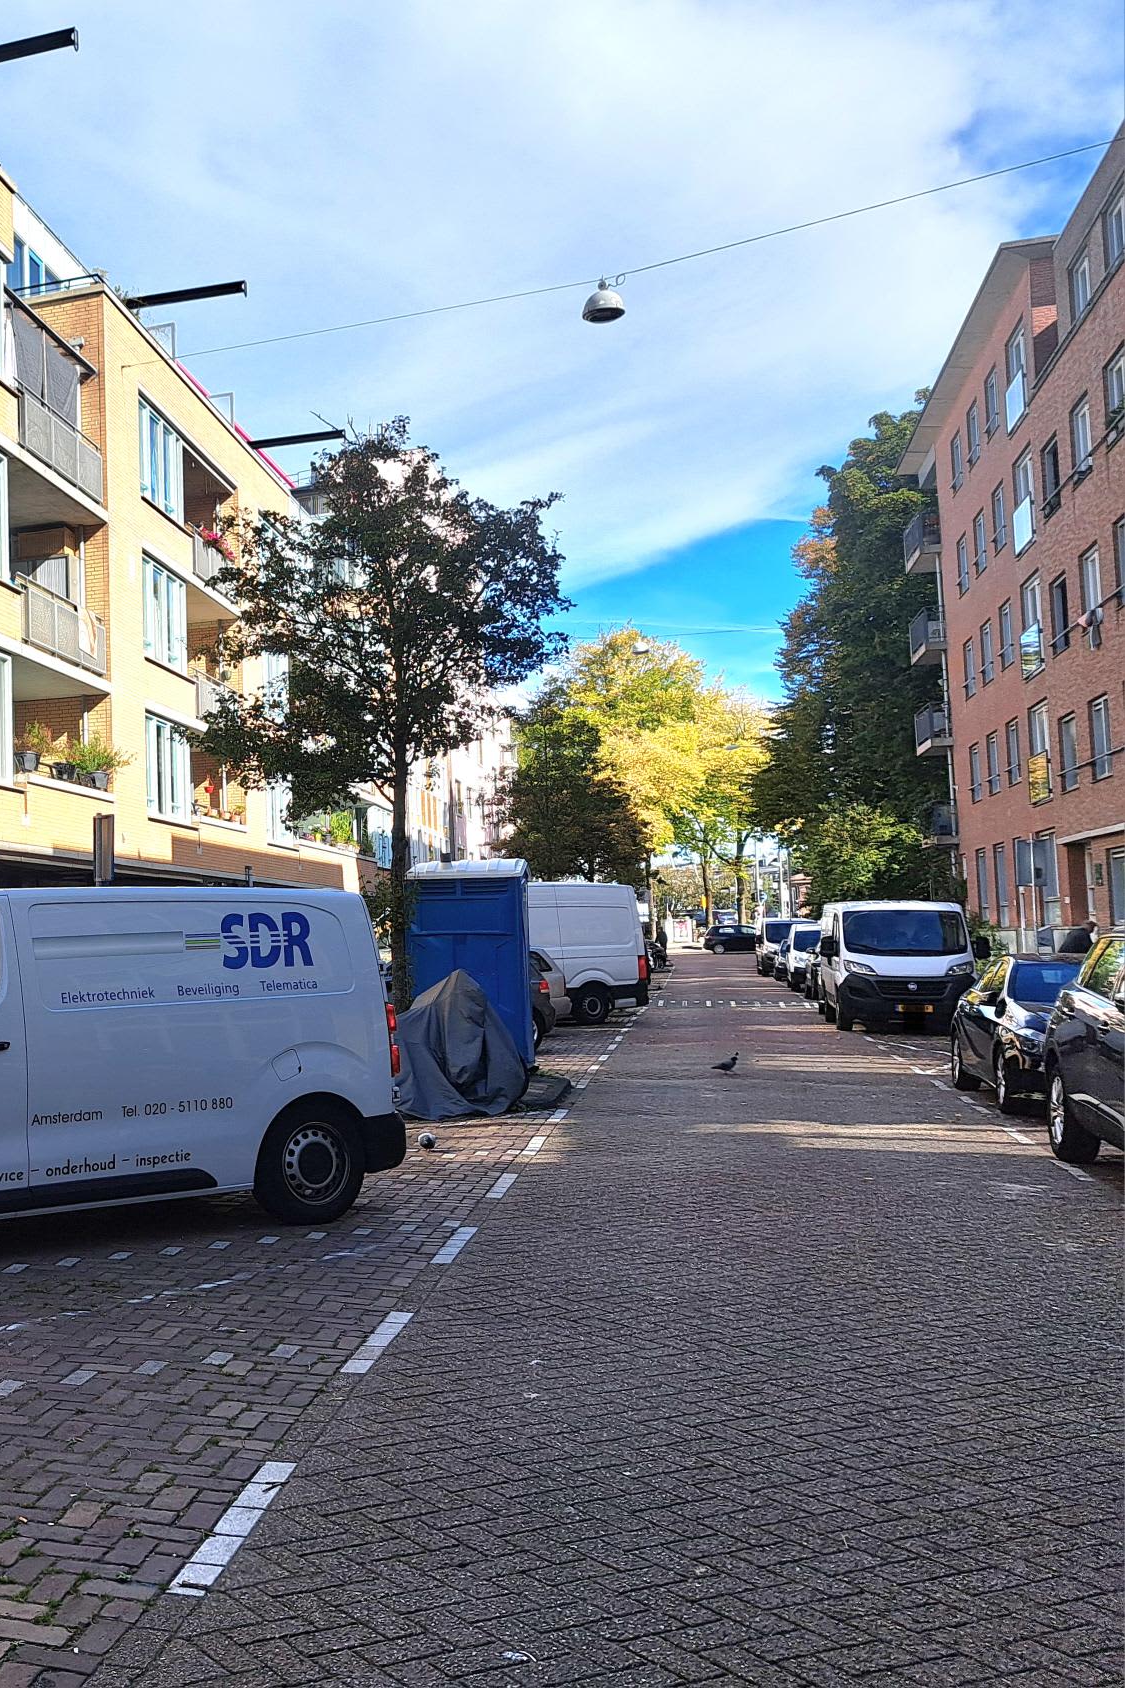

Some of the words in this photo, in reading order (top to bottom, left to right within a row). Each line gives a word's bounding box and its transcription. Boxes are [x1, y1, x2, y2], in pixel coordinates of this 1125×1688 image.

[221, 911, 314, 969] SDR
[60, 986, 156, 1004] Elektrotechniek
[177, 982, 240, 997] Beveiliging
[259, 979, 318, 992] Telematica
[31, 1109, 103, 1126] Amsterdam
[121, 1105, 140, 1118] Tel.
[144, 1102, 167, 1116] 020
[178, 1099, 208, 1113] 5110
[211, 1097, 233, 1110] 880
[45, 1154, 116, 1178] onderhoud
[135, 1149, 192, 1168] inspectie
